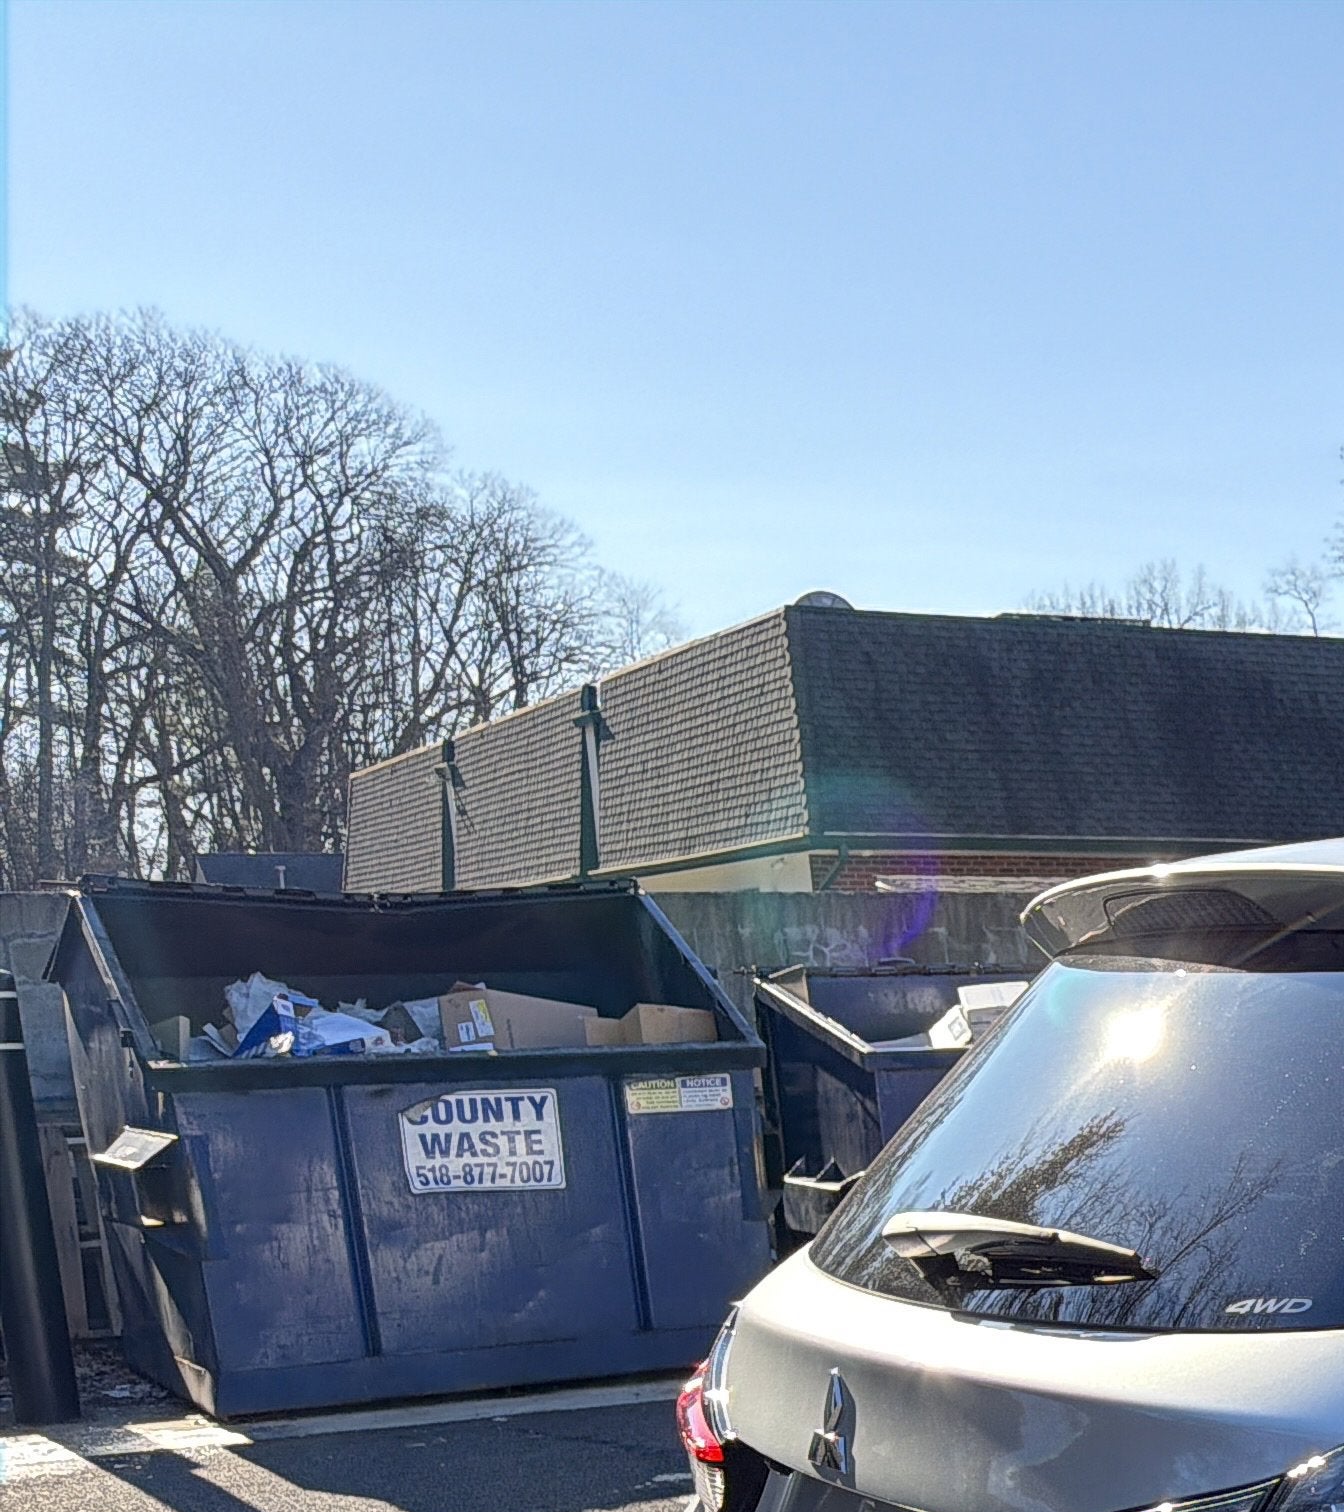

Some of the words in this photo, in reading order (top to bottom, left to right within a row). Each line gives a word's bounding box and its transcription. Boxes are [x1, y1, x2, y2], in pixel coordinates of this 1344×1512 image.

[630, 1081, 675, 1089] CAUTION
[686, 1078, 721, 1087] NOTICE
[418, 1129, 545, 1160] WASTE
[415, 1160, 555, 1187] 518-877-7007
[1225, 1298, 1312, 1314] 4WD
